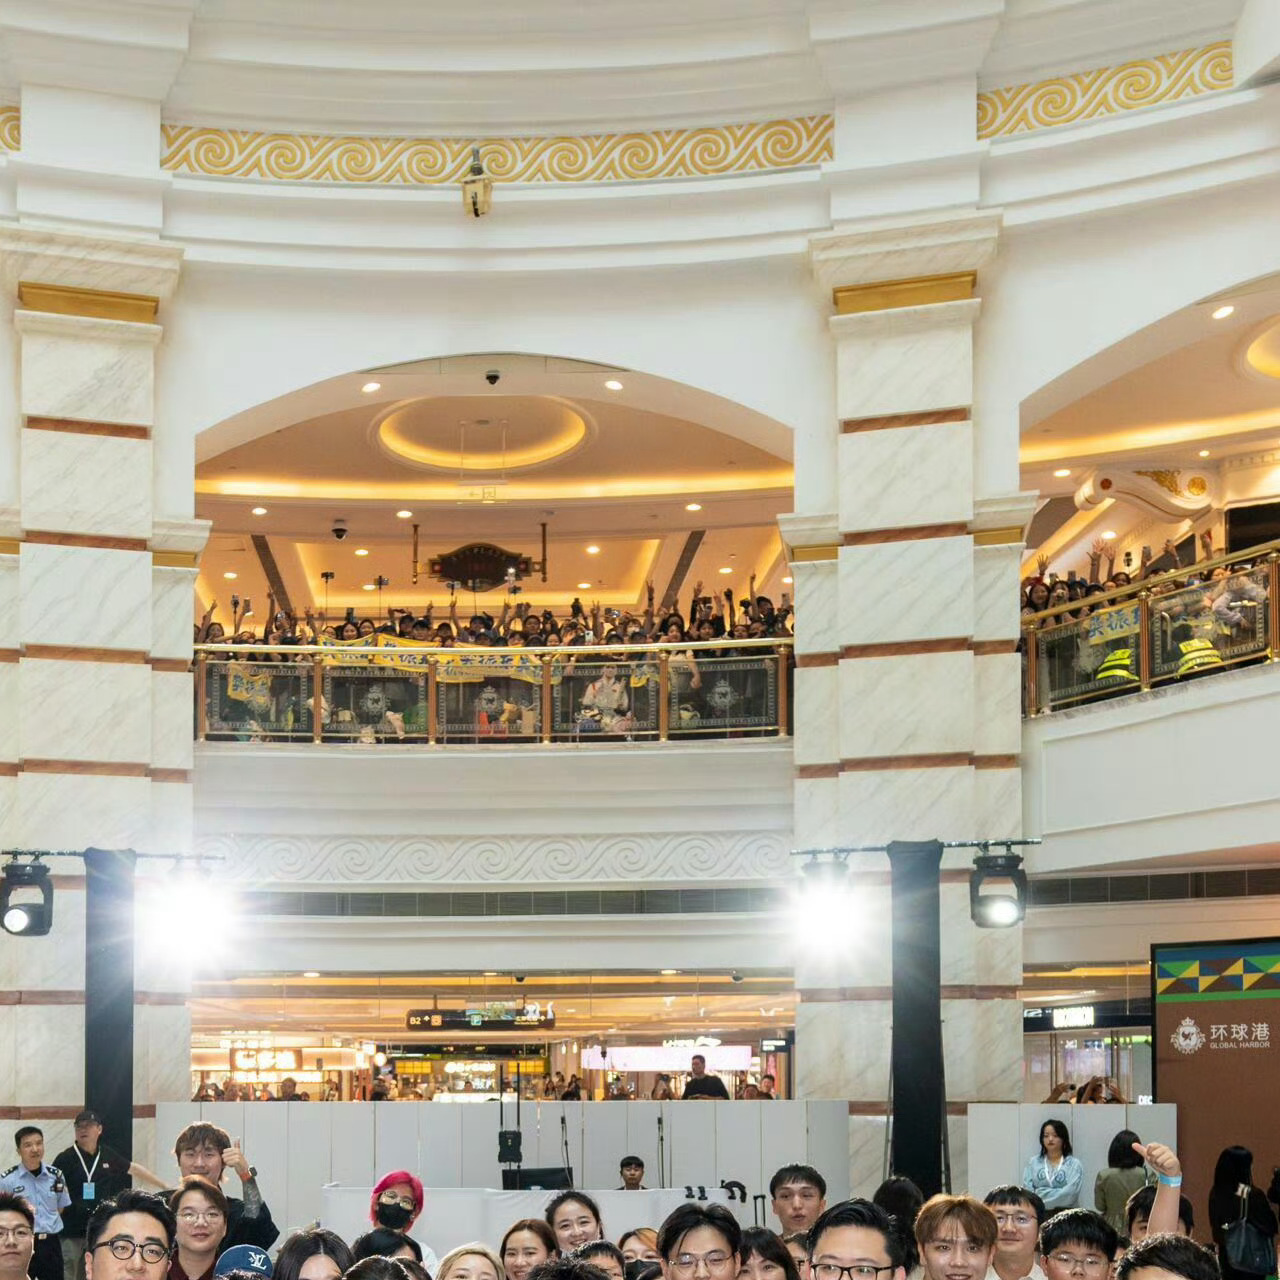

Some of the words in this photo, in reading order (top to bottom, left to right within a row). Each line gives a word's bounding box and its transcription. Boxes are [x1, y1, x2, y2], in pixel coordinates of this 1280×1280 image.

[1210, 1022, 1271, 1041] 环球港
[1210, 1041, 1238, 1049] GLOBAL
[1239, 1040, 1271, 1049] HARBOR
